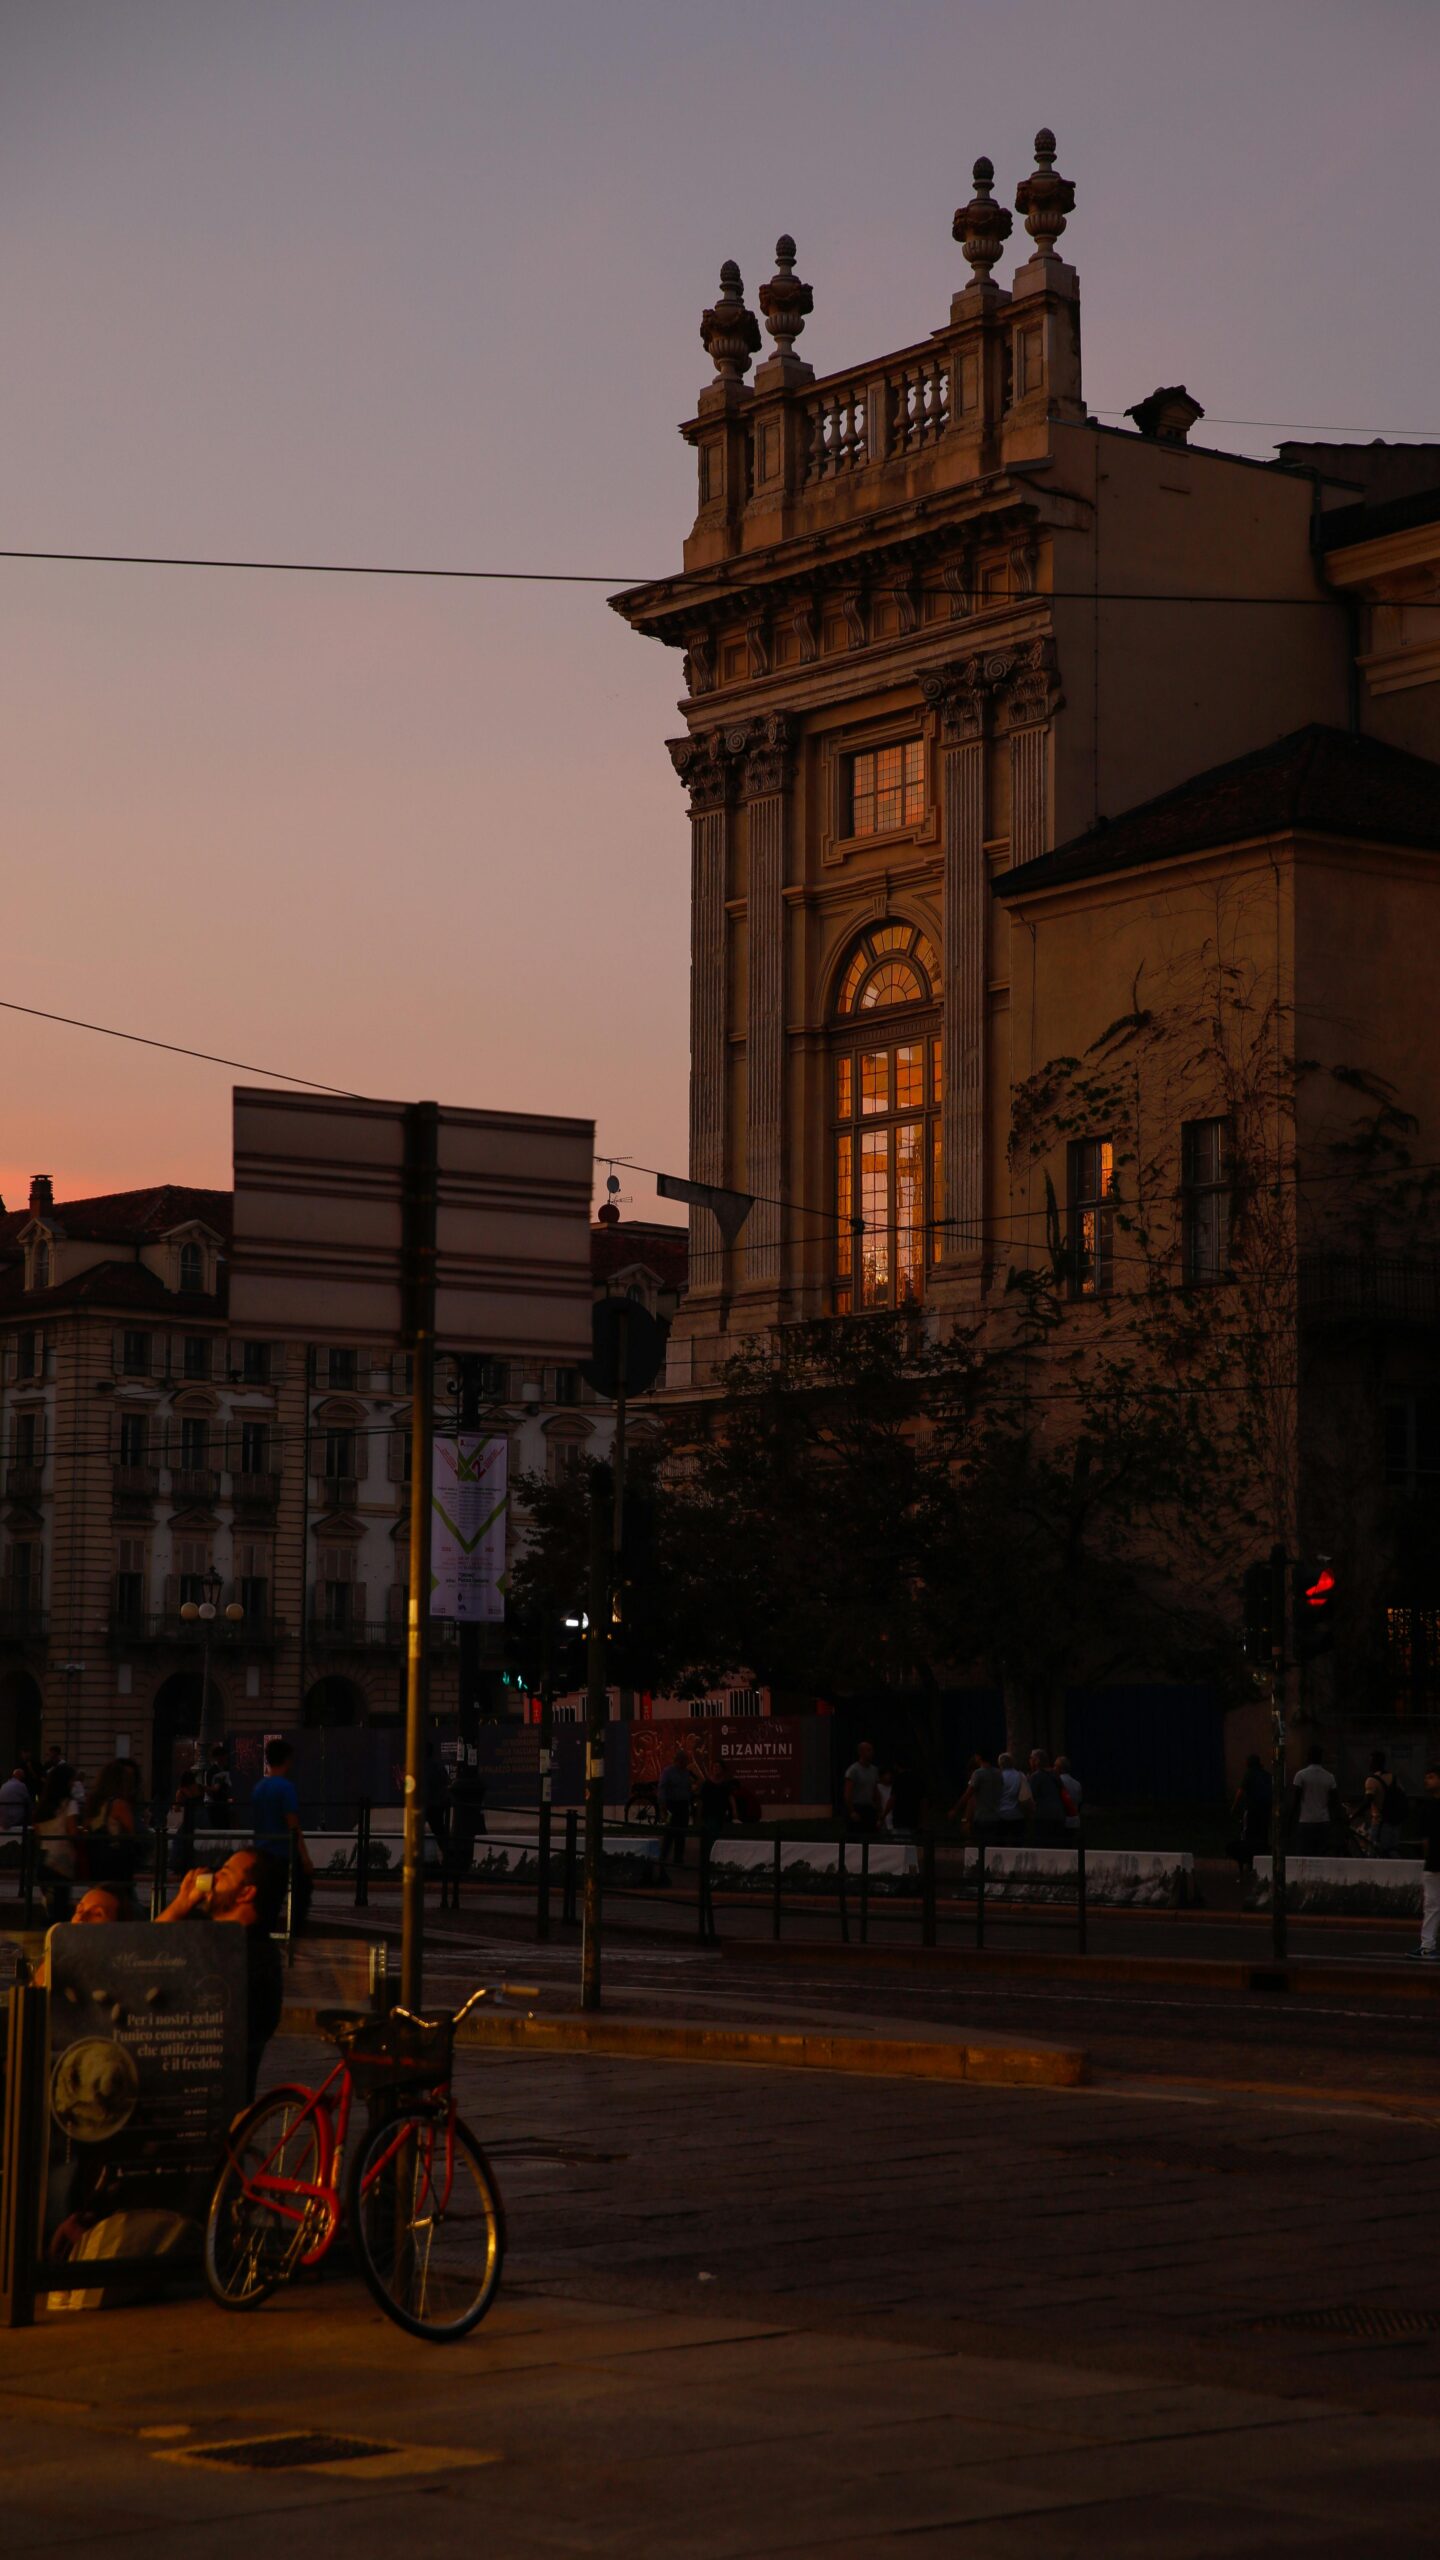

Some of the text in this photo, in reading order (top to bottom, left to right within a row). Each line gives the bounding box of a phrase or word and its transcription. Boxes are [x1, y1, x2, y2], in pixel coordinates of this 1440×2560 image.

[721, 1743, 793, 1756] BIZANTINI
[127, 2009, 224, 2026] Per i nostri gelati
[155, 2028, 223, 2040] conservante
[137, 2040, 223, 2056] che utilizziamo
[171, 2056, 180, 2071] il
